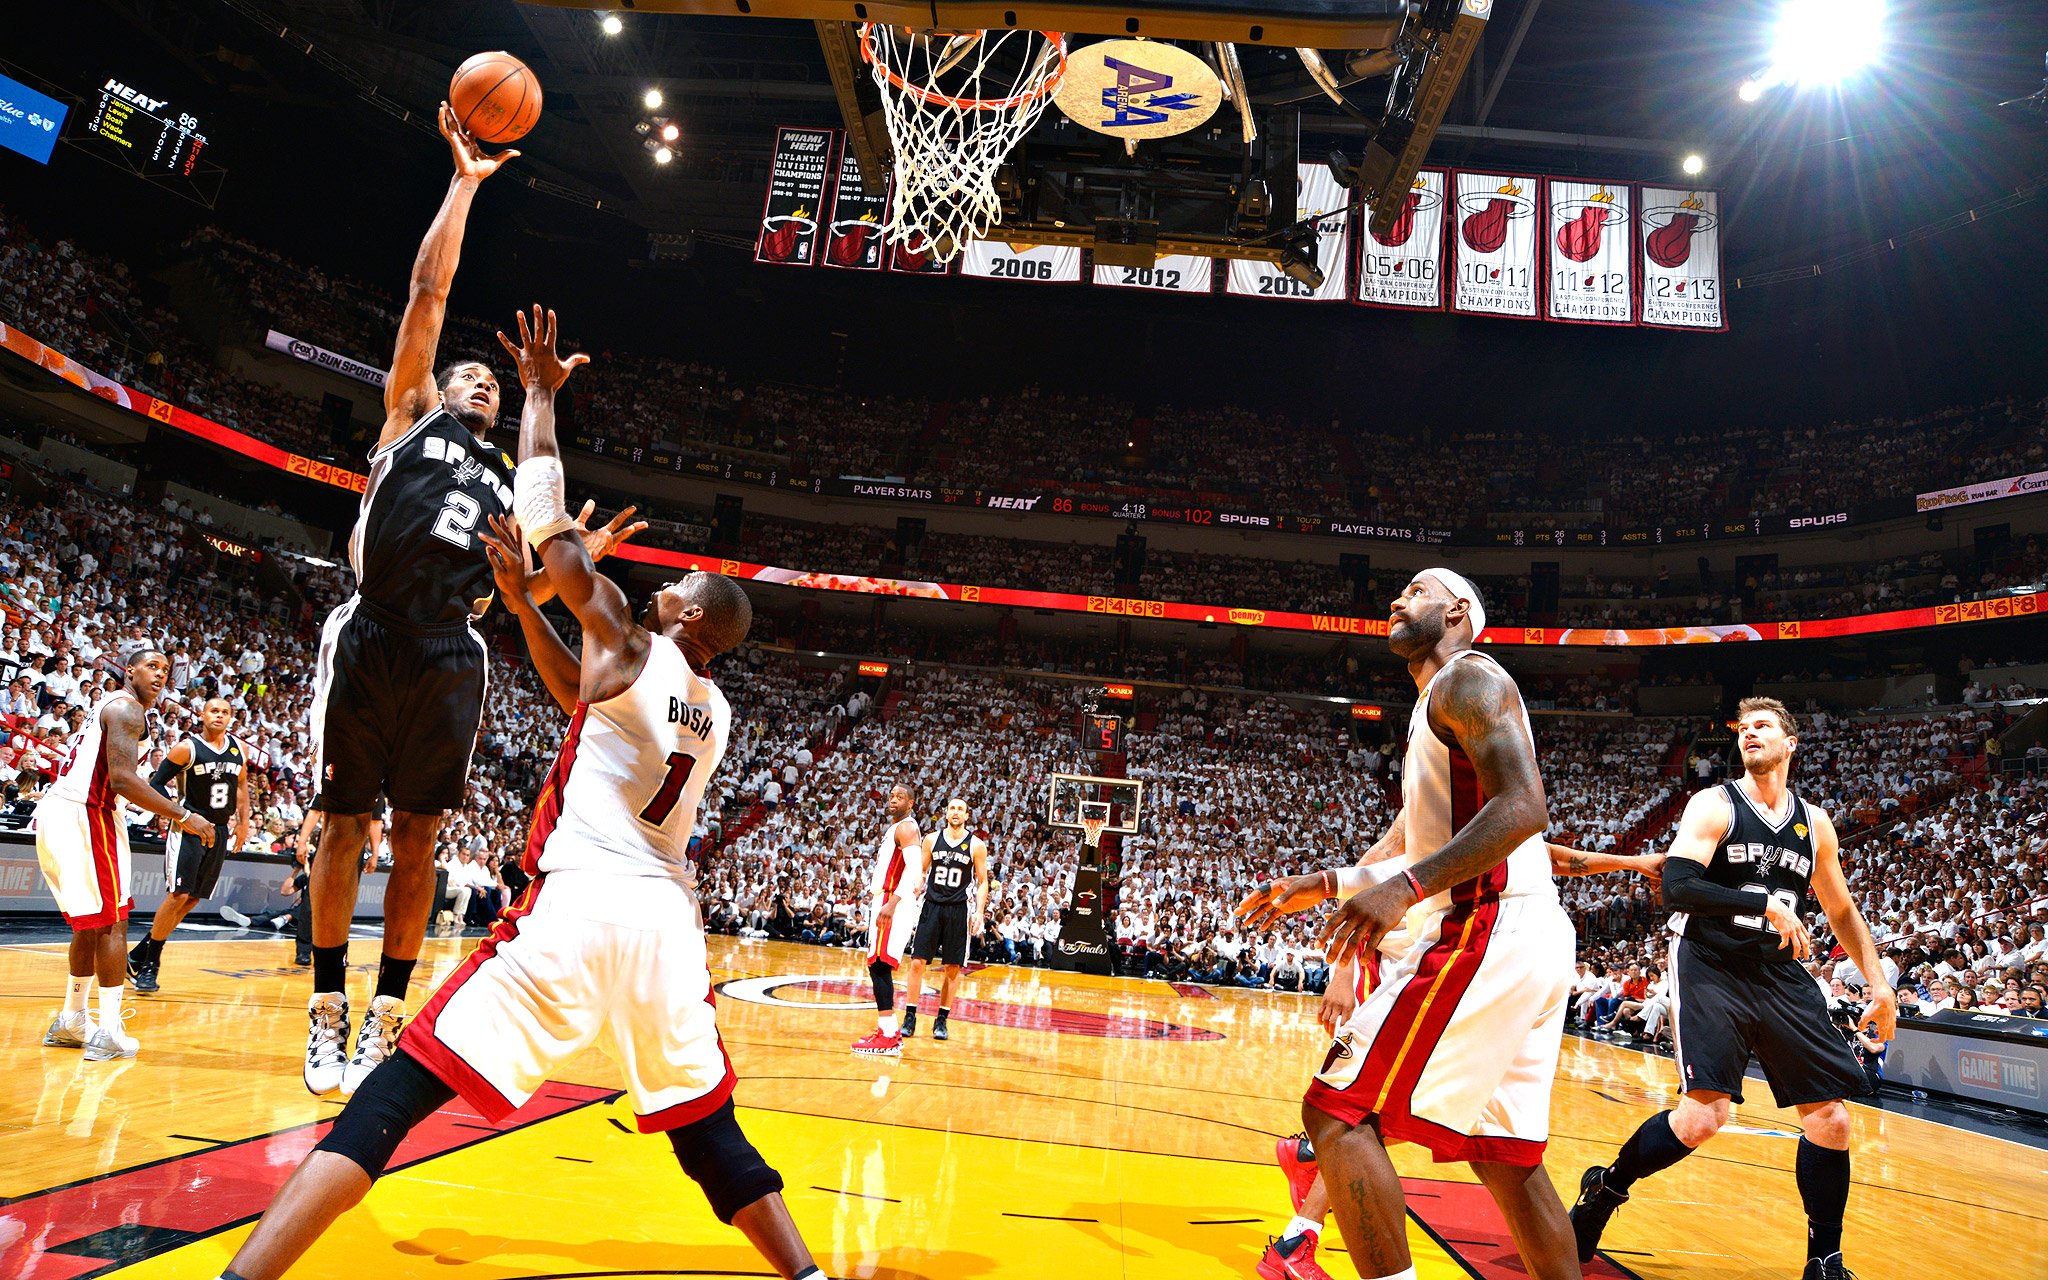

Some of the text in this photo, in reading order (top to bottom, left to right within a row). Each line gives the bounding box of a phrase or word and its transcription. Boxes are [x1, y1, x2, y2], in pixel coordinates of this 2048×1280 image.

[102, 93, 109, 102] 6
[111, 99, 134, 114] James
[104, 78, 168, 112] HEAT
[1117, 84, 1129, 112] ARENA
[108, 105, 128, 120] Lewis
[179, 112, 198, 130] 86
[88, 122, 98, 132] 15
[100, 128, 132, 148] Chalmers
[94, 116, 100, 124] 3
[102, 120, 123, 135] Wade
[105, 113, 124, 126] Bosh
[158, 138, 164, 146] 0
[784, 133, 823, 143] MIAMI
[790, 142, 825, 151] HEAT
[776, 161, 824, 171] DIVISION
[778, 153, 825, 162] ATLANTIC
[774, 169, 822, 180] CHAMPIONS
[990, 258, 1052, 280] 2006
[1366, 254, 1434, 279] 05 06
[1464, 263, 1528, 288] 10 11
[1122, 266, 1181, 289] 2012
[1557, 271, 1623, 294] 11 12
[1649, 276, 1715, 300] 12 13
[1365, 286, 1434, 302] CHAMPIONS
[1460, 295, 1530, 310] CHAMPIONS
[1555, 303, 1626, 316] CHAMPIONS
[1648, 308, 1718, 322] CHAMPIONS
[295, 343, 312, 354] FOX
[318, 352, 342, 368] SUN
[341, 360, 384, 384] SPORTS
[152, 399, 170, 422] $4
[290, 455, 349, 486] $2 $4 $6
[576, 436, 591, 446] MIN
[614, 446, 628, 456] PTS
[654, 455, 669, 464] REB
[696, 463, 719, 473] ASSTS
[726, 463, 732, 471] 7
[744, 470, 762, 480] STLS
[789, 478, 807, 488] BLKS
[815, 478, 821, 486] 0
[725, 471, 731, 479] 0
[814, 485, 820, 494] 0
[430, 490, 481, 550] 2
[853, 484, 1451, 539] PLAYER STATS HEAT 86 BONUS 4:18 BONUS 102 SPURS PLAYER STATS 2 Leonard
[1112, 511, 1142, 519] QUARTER
[1554, 530, 1565, 538] 26
[1577, 533, 1593, 541] REB
[1622, 532, 1647, 541] ASSTS
[1676, 528, 1696, 537] STLS
[1725, 524, 1745, 533] BLKS
[1790, 512, 1848, 528] SPURS
[723, 560, 738, 576] $2
[963, 586, 978, 600] $2
[1089, 597, 1163, 615] $2 $4 $6 $8
[1232, 611, 1263, 622] Denny's
[1937, 596, 2036, 622] $2 $4 $6 $8
[1312, 615, 1359, 633] VALUE
[1780, 622, 1798, 638] $4
[1526, 628, 1542, 643] $4
[668, 696, 713, 742] BOSH
[1094, 720, 1116, 730] 4:18
[1102, 730, 1112, 748] 5
[210, 783, 229, 809] 8
[640, 751, 696, 826] 1
[932, 851, 970, 865] SPURS
[1727, 842, 1811, 878] SPURS
[934, 866, 962, 888] 20
[1074, 941, 1107, 955] Finals
[1961, 1056, 2036, 1091] GAME TIME
